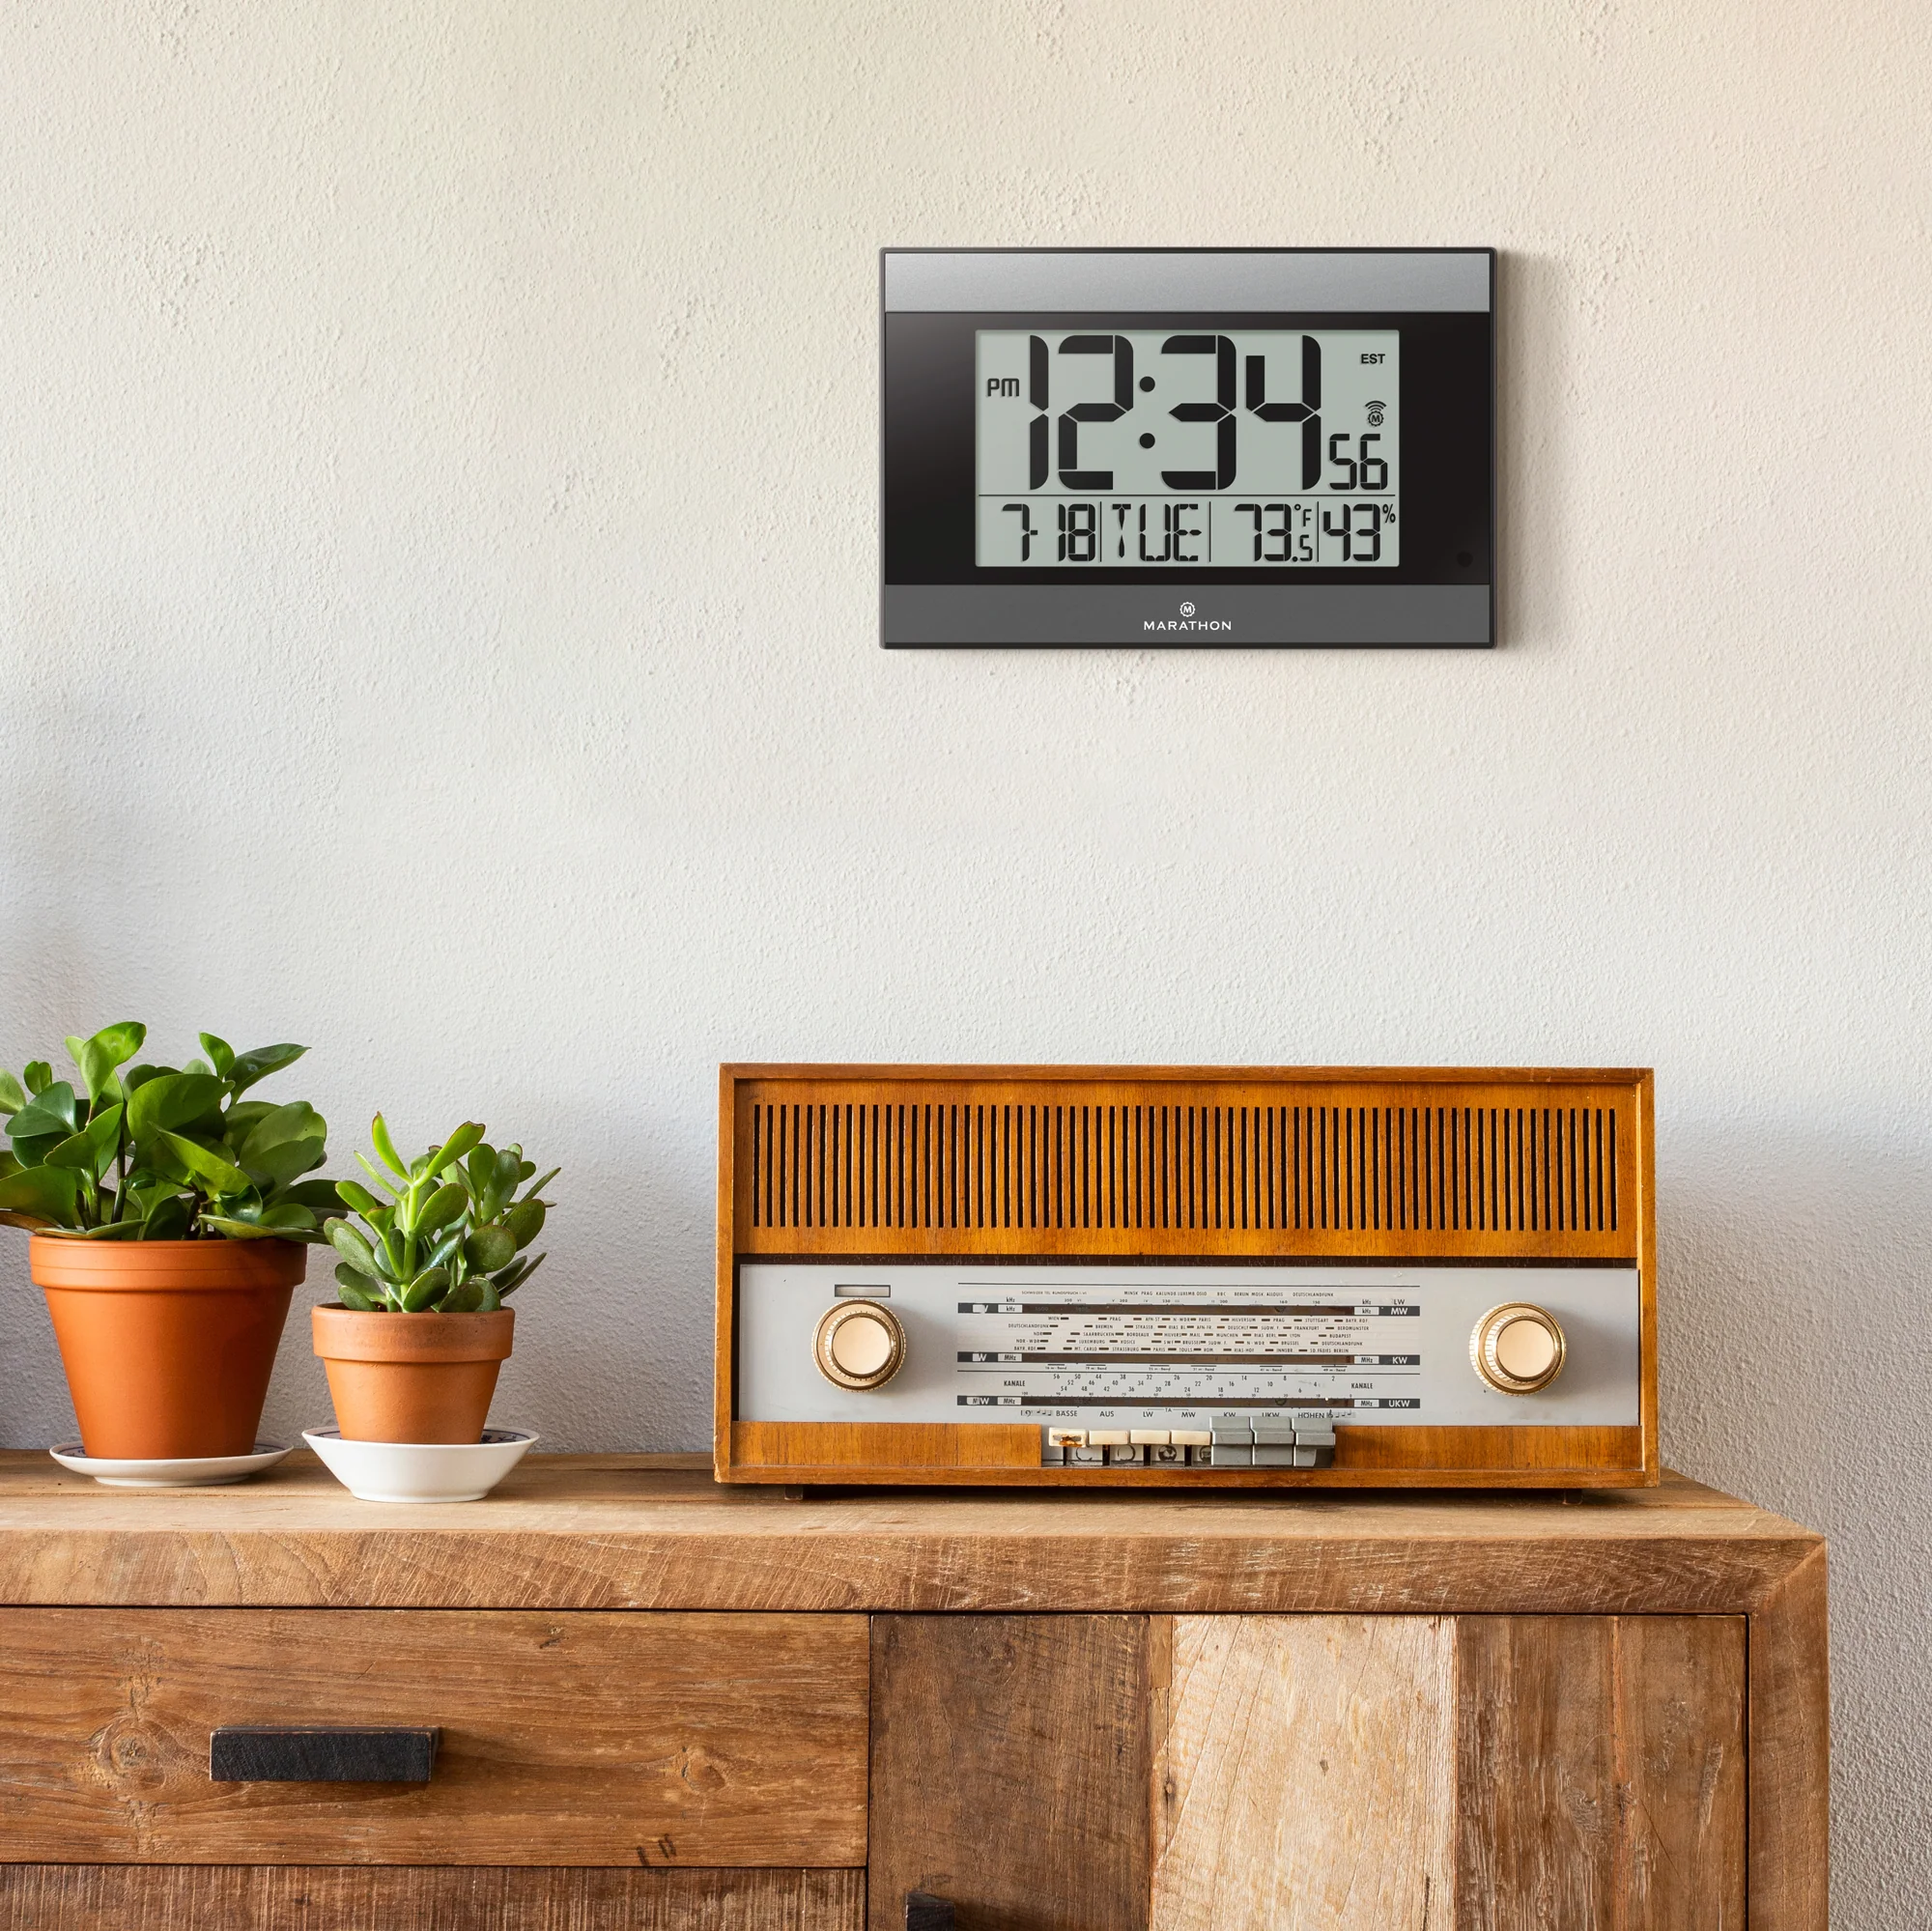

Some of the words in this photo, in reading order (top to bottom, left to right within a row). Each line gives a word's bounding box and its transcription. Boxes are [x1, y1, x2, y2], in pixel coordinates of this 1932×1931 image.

[1360, 354, 1385, 364] EST
[987, 378, 1020, 397] PM
[1030, 335, 1321, 491] 12:34
[1329, 434, 1388, 490] 56
[1112, 503, 1202, 561] TUE
[1144, 620, 1232, 631] MARATHON
